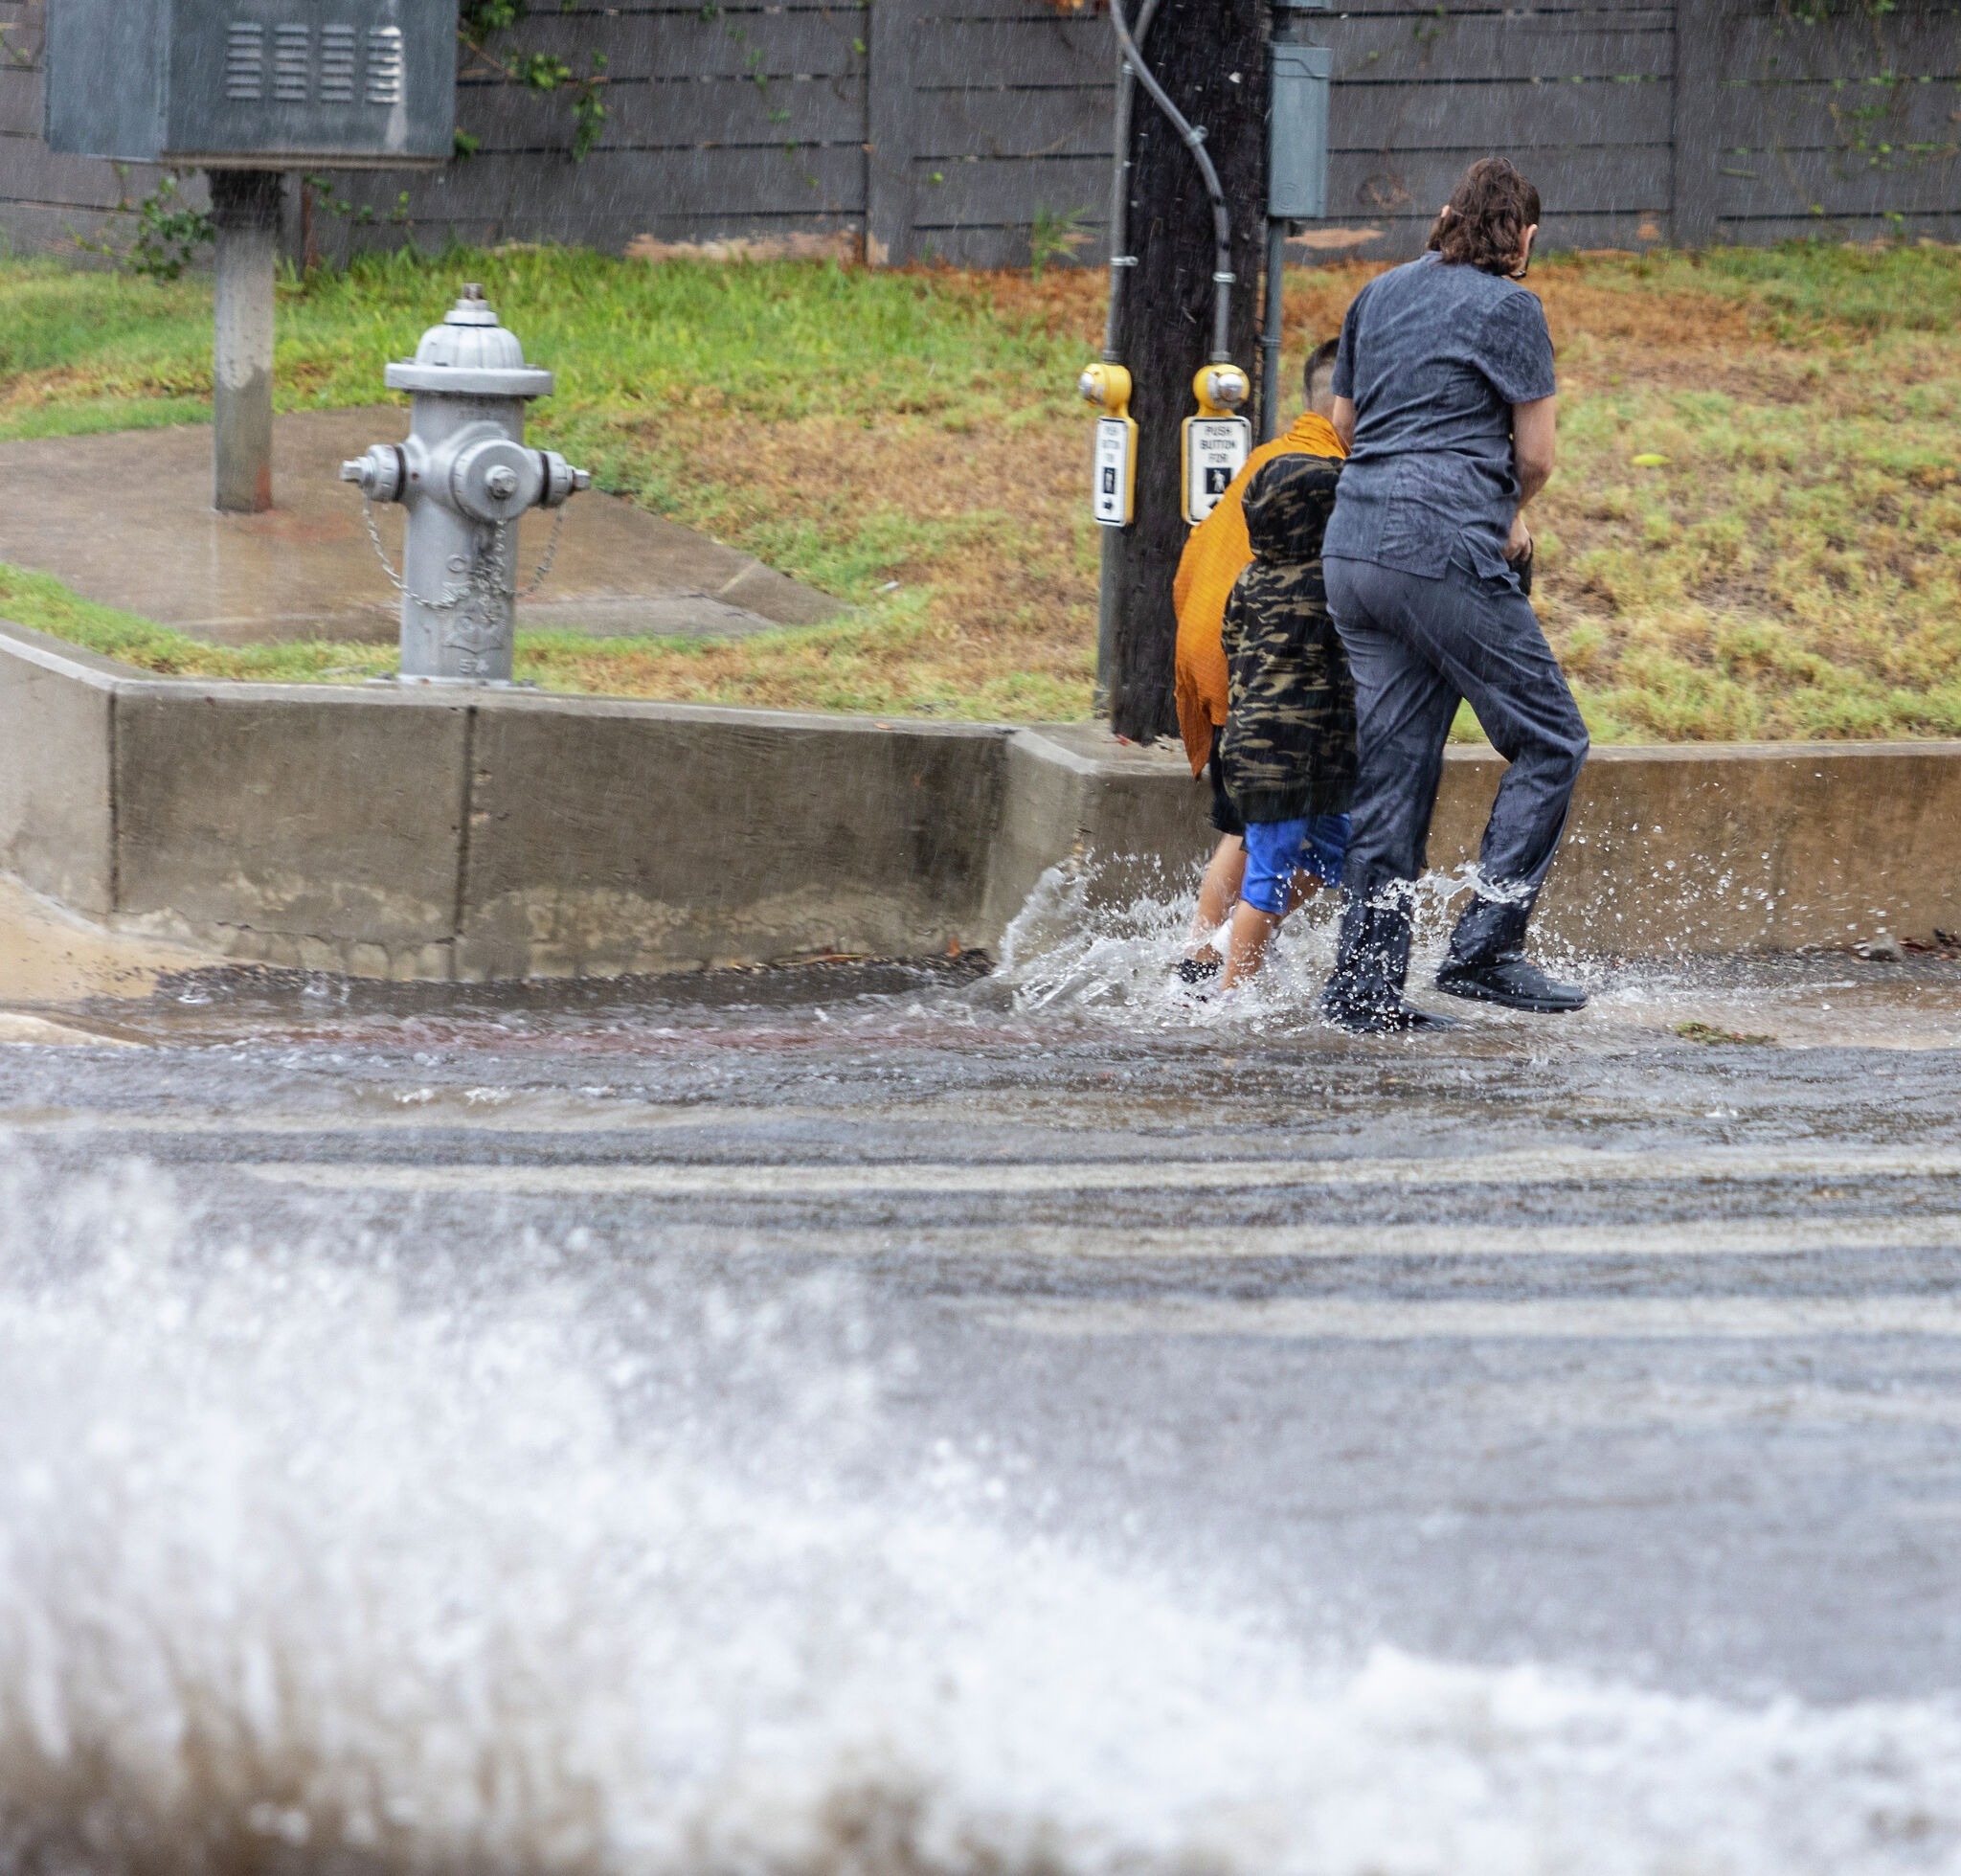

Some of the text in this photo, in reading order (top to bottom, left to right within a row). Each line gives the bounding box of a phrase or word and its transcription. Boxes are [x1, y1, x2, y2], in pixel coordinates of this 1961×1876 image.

[1205, 426, 1233, 437] PUSH
[1201, 440, 1237, 449] BUTTON
[1209, 453, 1228, 463] FOR
